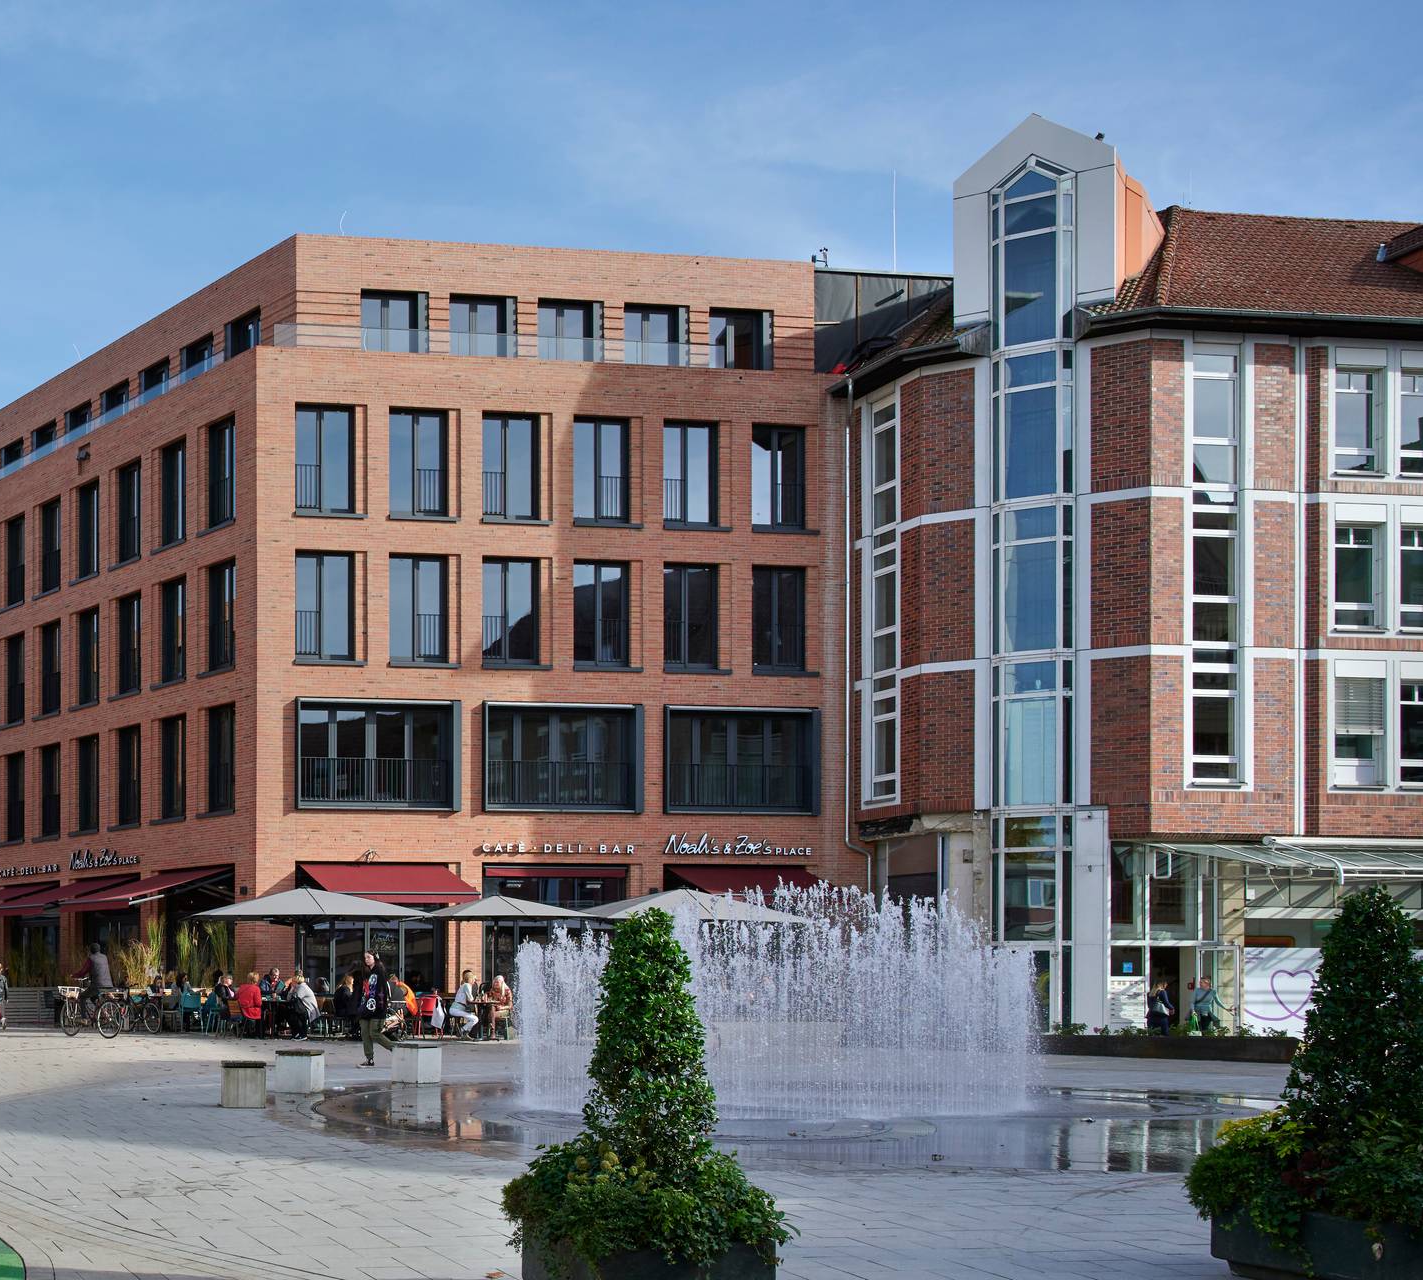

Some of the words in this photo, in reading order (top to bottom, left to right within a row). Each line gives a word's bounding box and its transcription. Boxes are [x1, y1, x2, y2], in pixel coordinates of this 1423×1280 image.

[544, 843, 582, 853] DELI
[599, 844, 635, 854] BAR
[664, 832, 720, 855] Noah's
[724, 843, 732, 855] &
[735, 835, 772, 855] Zoe's
[775, 847, 812, 856] PLACE
[69, 849, 93, 870] Noah's
[118, 855, 137, 865] PLACE
[20, 866, 37, 876] DELI
[42, 864, 59, 873] BAR
